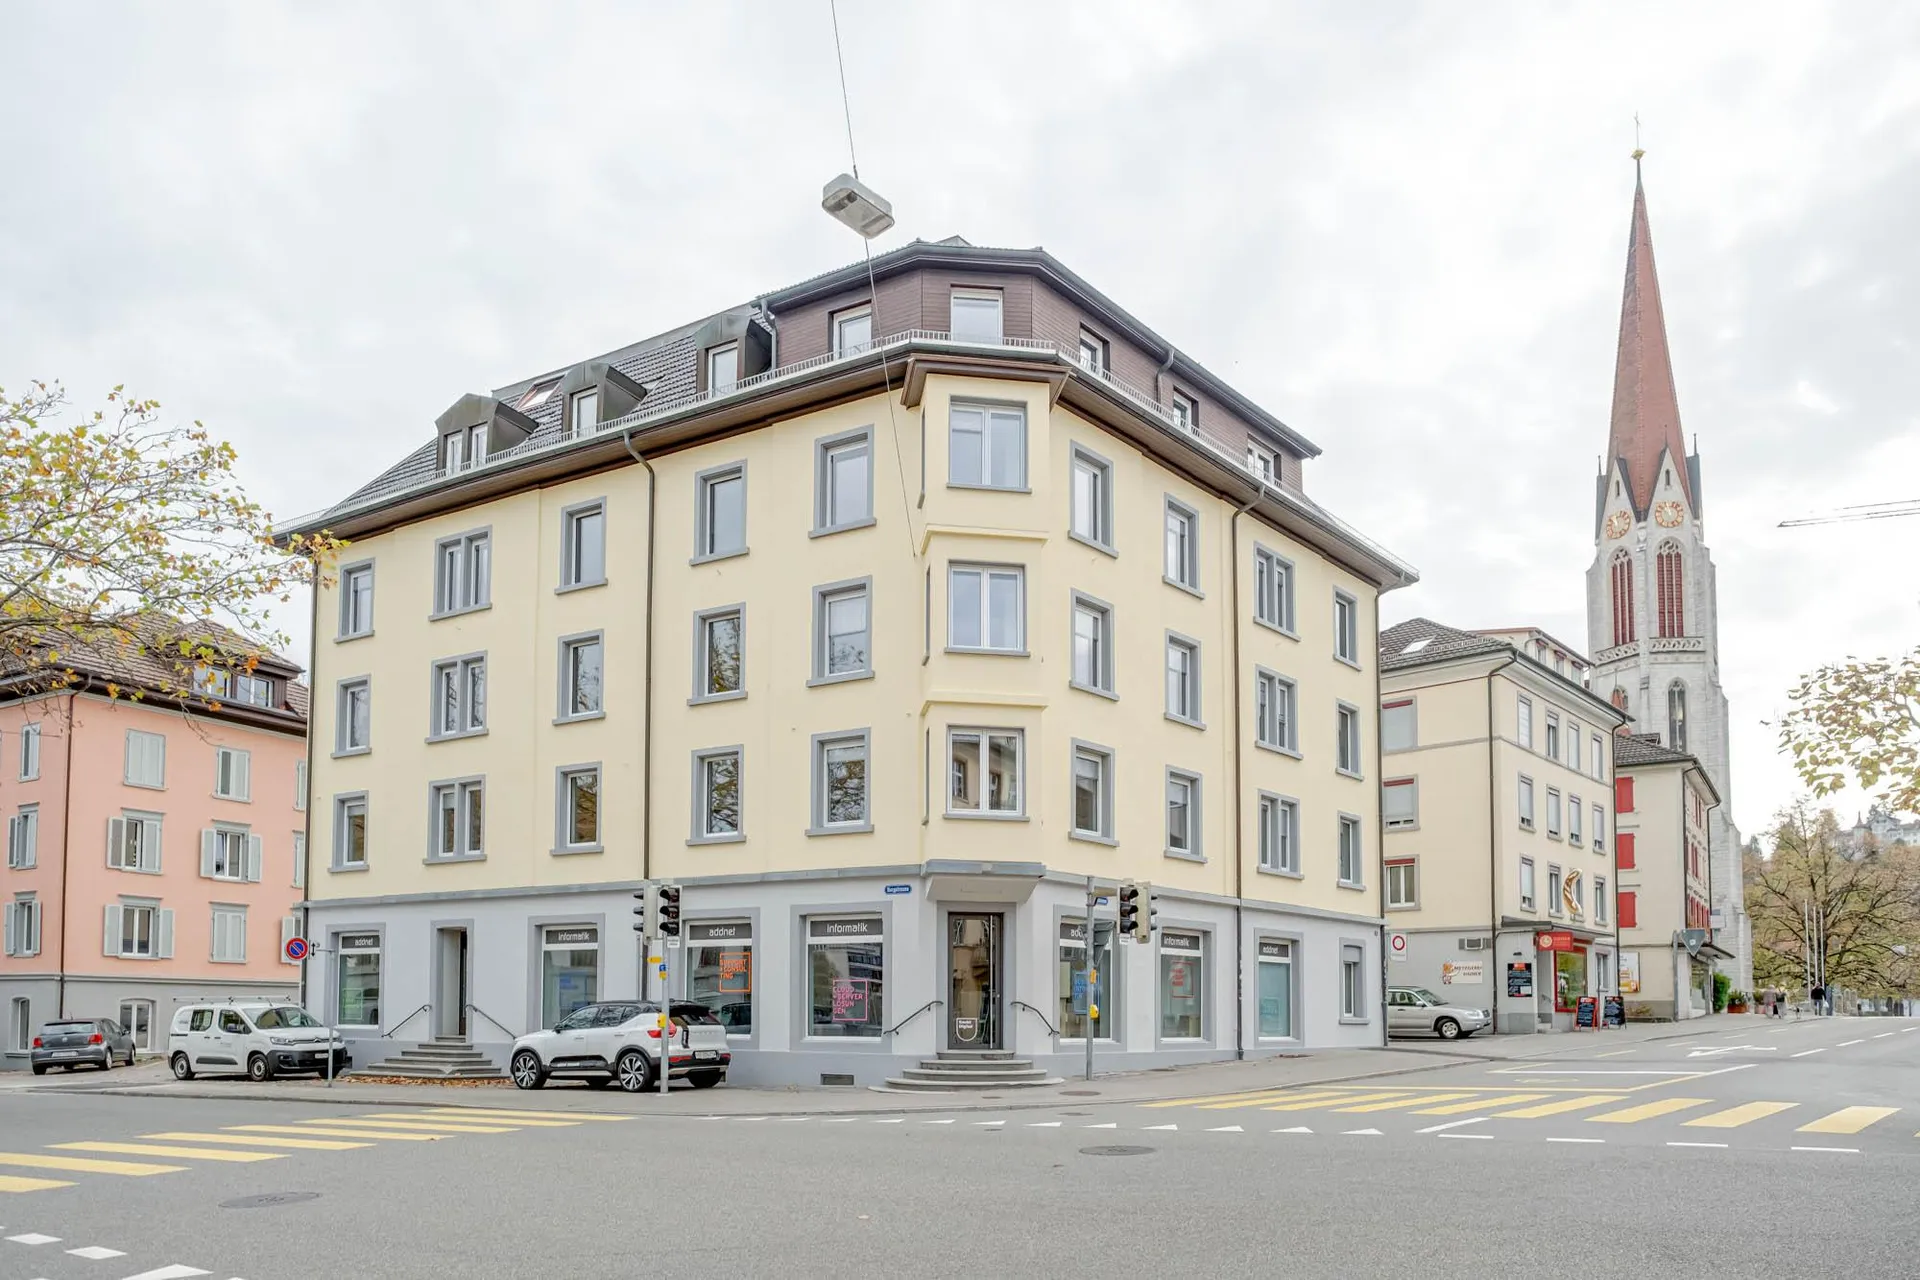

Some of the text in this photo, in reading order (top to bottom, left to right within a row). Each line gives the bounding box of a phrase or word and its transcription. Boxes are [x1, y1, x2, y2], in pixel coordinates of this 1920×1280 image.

[709, 926, 736, 937] addnet
[826, 922, 868, 933] informatik
[558, 931, 590, 941] informatik
[1163, 936, 1190, 947] informatik
